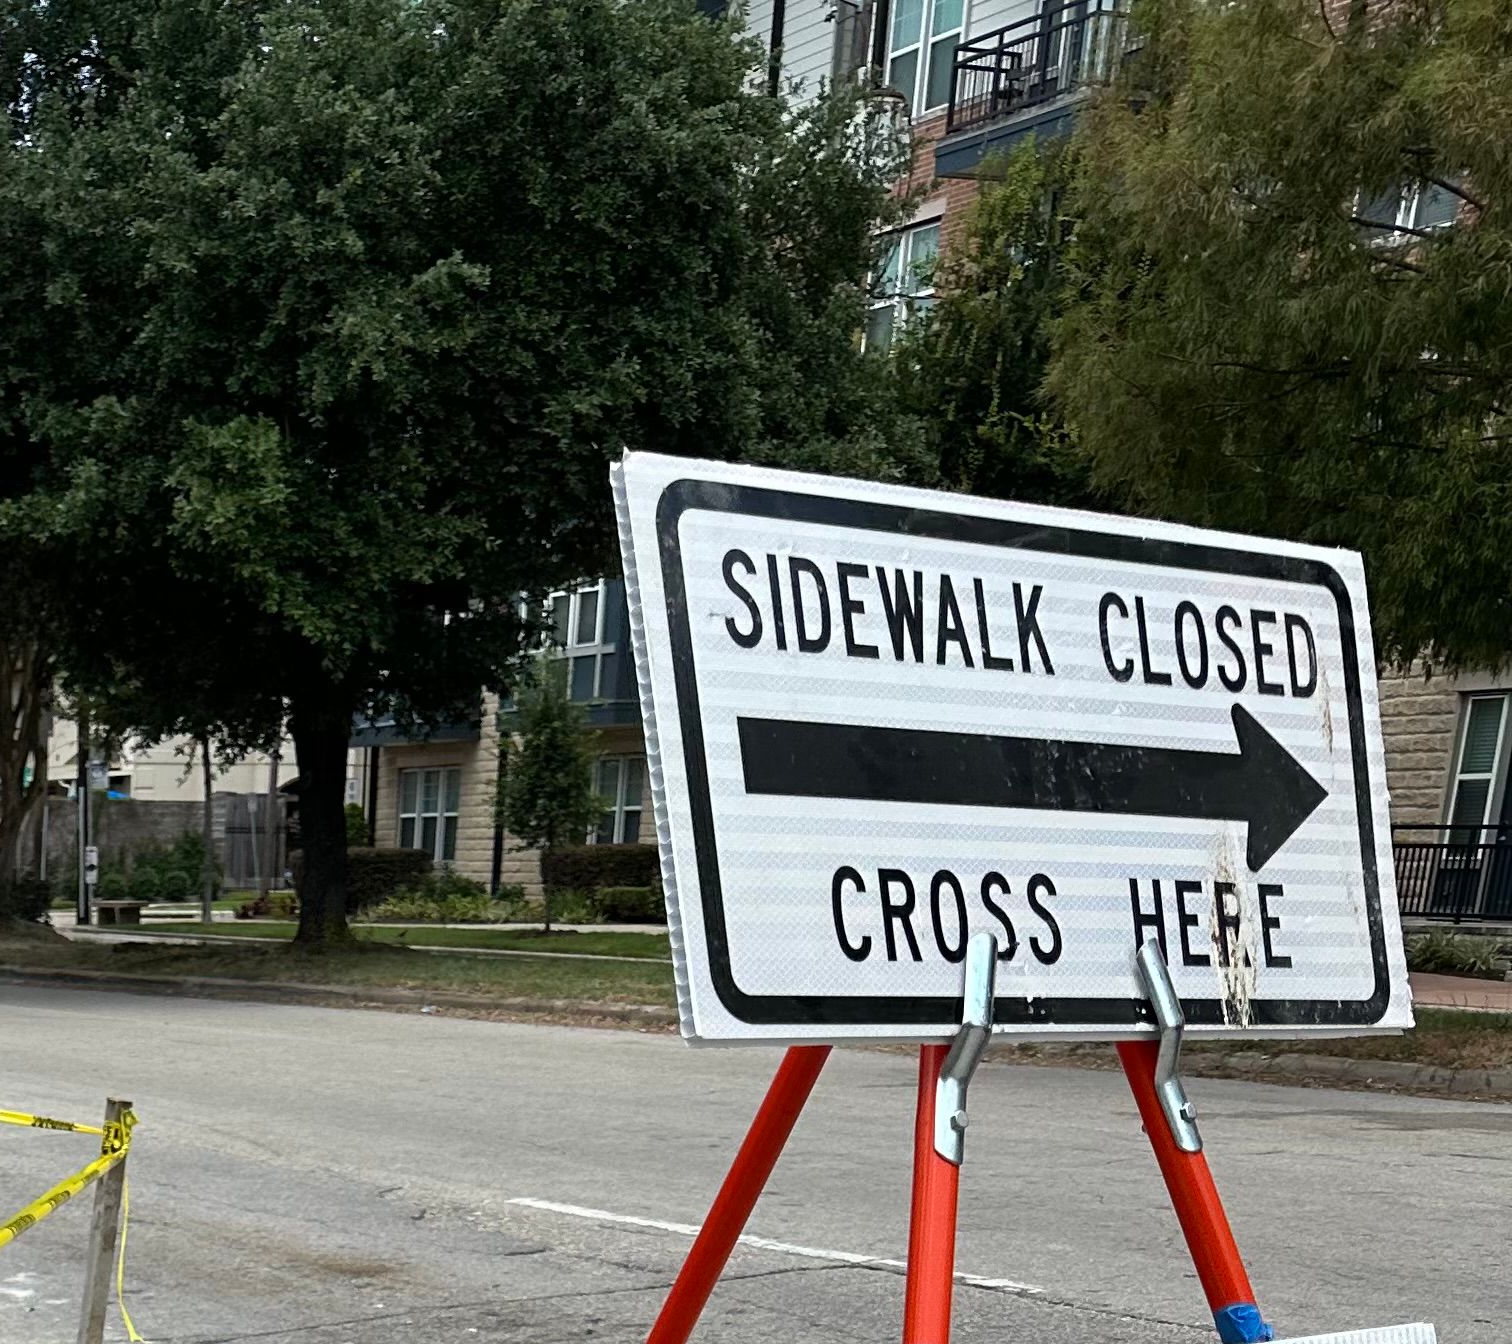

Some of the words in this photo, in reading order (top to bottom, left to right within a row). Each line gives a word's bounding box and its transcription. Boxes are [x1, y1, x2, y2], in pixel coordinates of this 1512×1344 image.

[722, 548, 1056, 676] SIDEWALK
[1099, 591, 1318, 699] CLOSED
[831, 865, 1063, 966] CROSS
[1129, 877, 1293, 969] HERE
